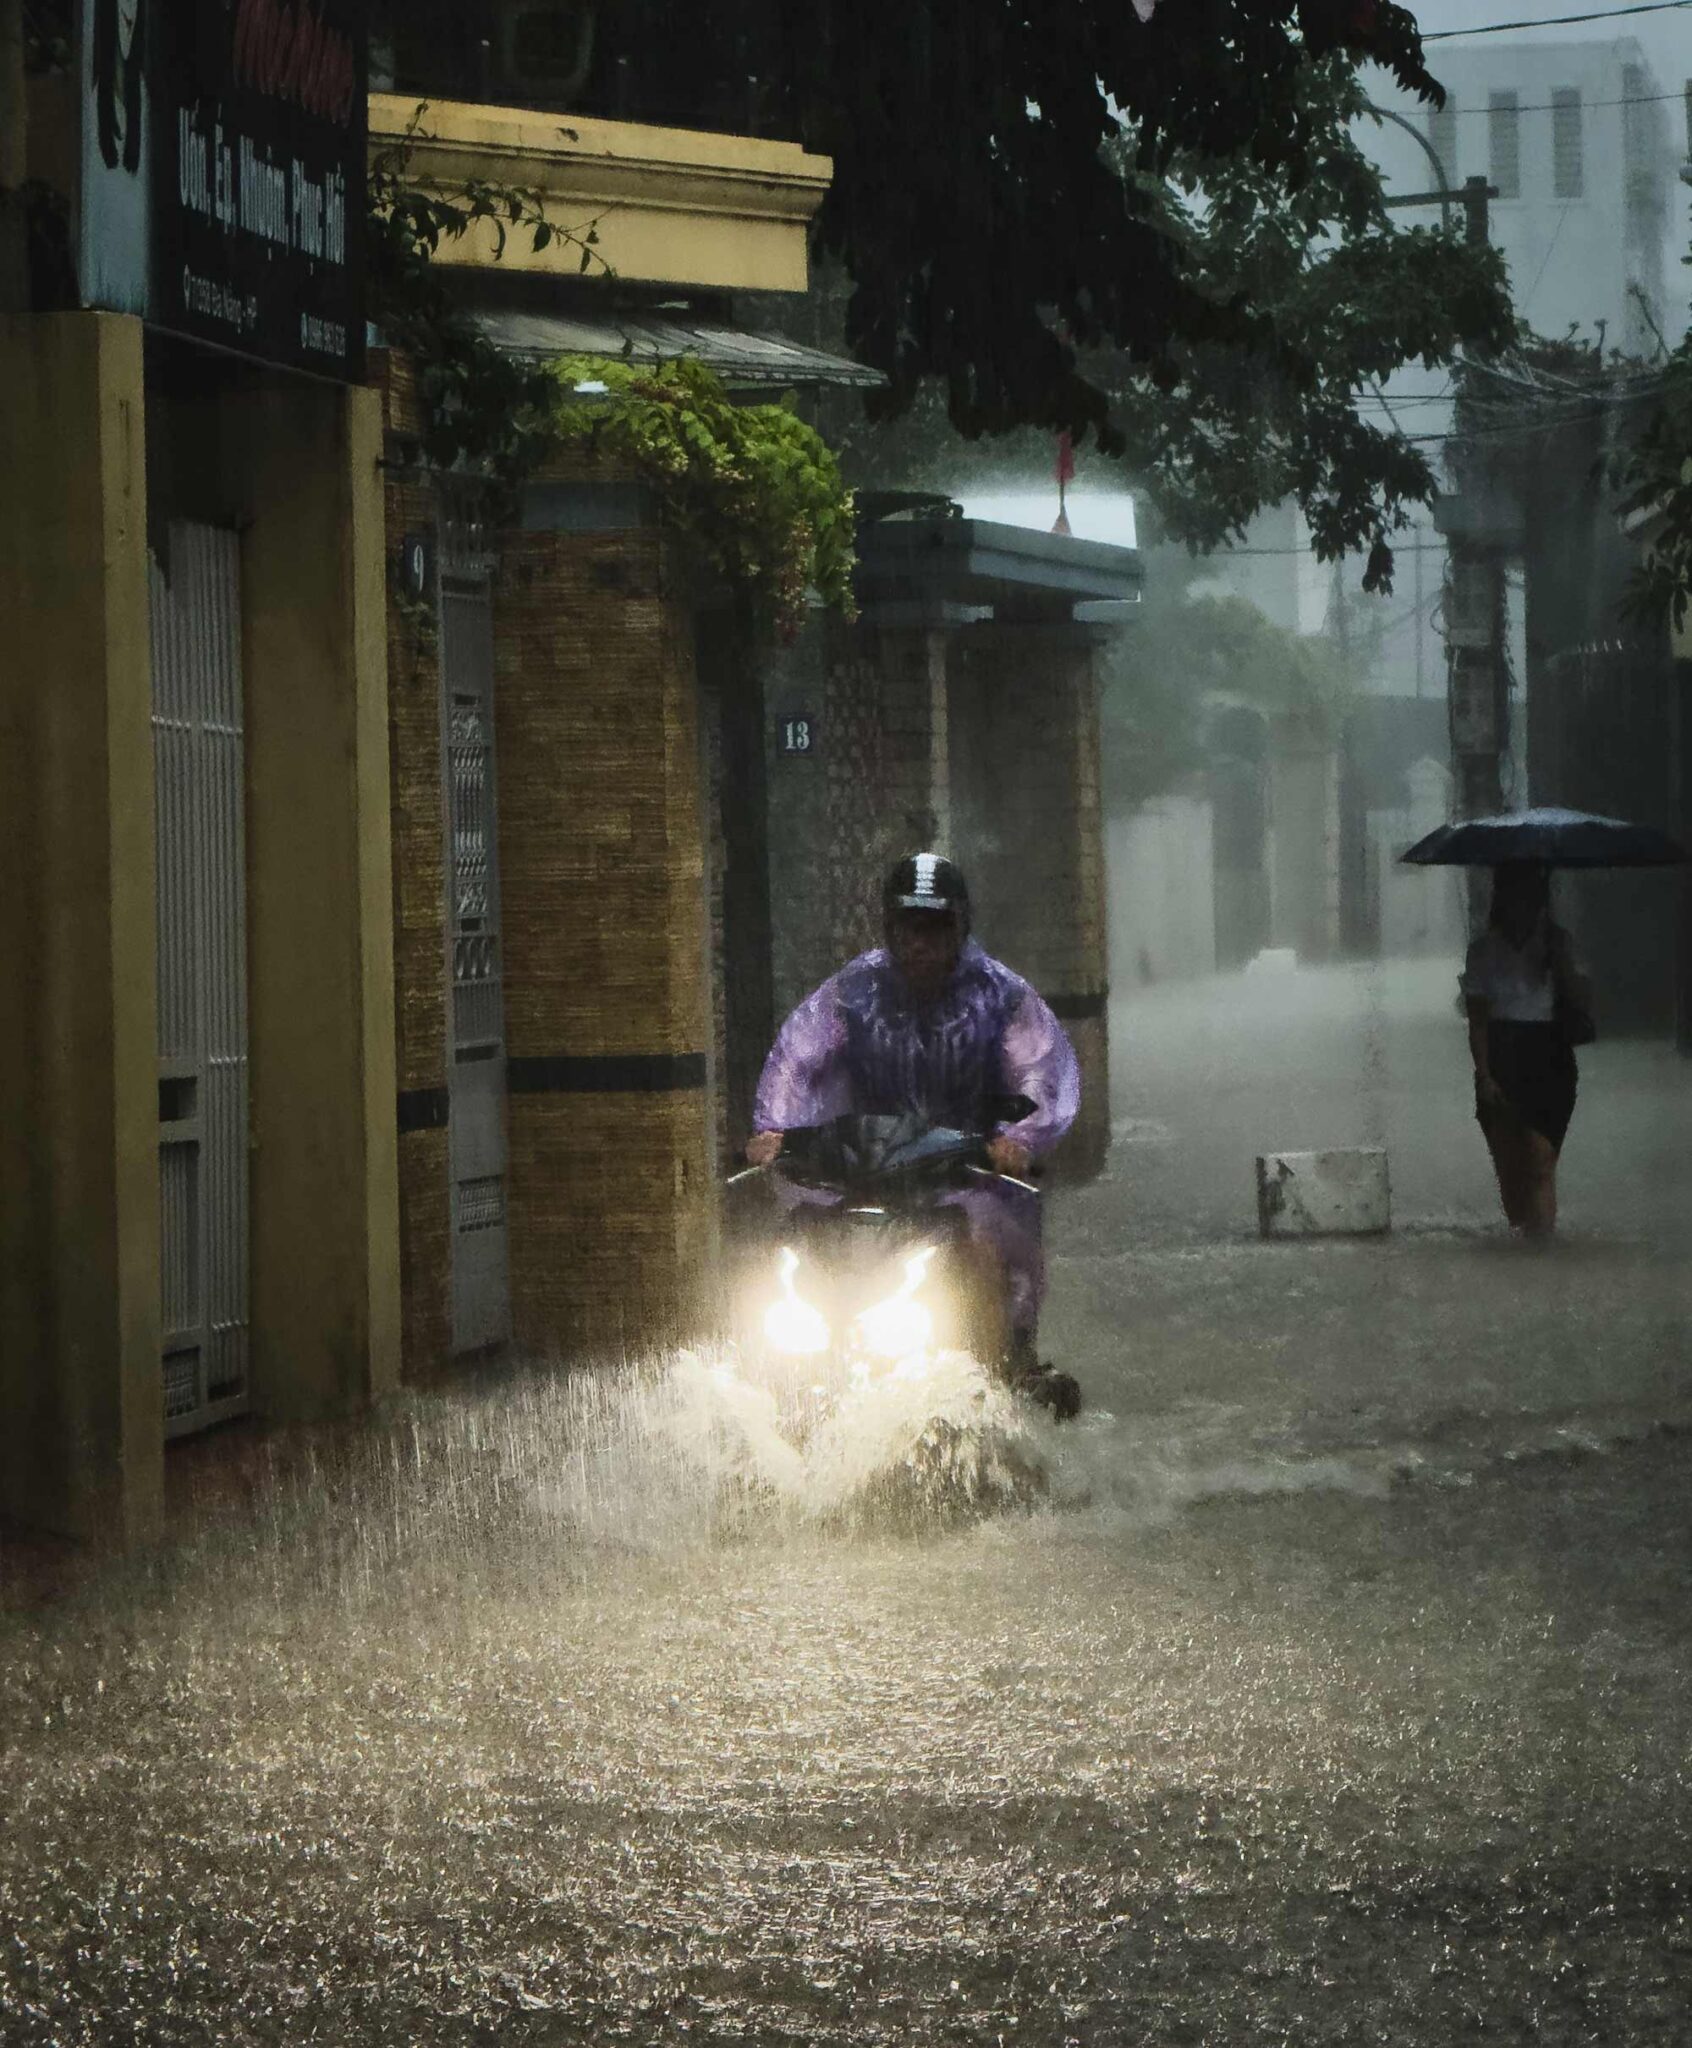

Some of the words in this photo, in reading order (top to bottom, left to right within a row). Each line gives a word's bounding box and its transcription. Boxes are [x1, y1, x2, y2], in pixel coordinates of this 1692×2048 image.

[292, 156, 323, 275] Phục
[325, 161, 345, 265] Hồi
[413, 544, 424, 592] 9
[785, 720, 810, 750] 13
